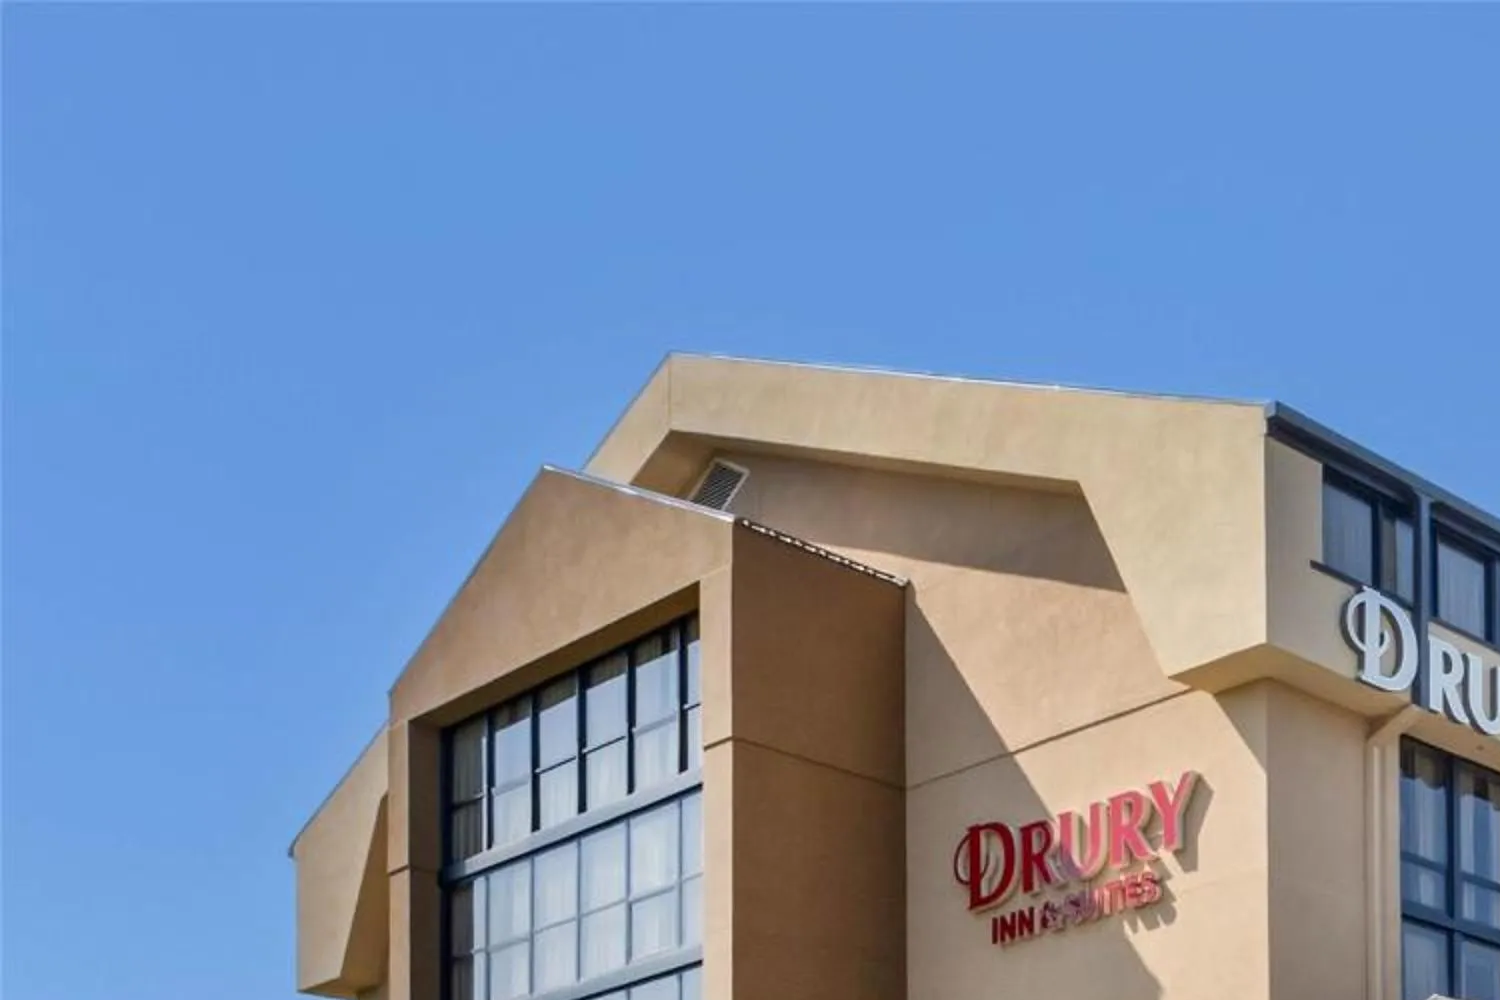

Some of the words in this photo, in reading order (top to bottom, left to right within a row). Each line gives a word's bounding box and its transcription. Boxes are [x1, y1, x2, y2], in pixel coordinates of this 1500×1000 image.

[953, 769, 1199, 913] DRURY
[991, 906, 1036, 945] INN
[1040, 901, 1066, 931] &
[1063, 871, 1163, 926] SUITES
